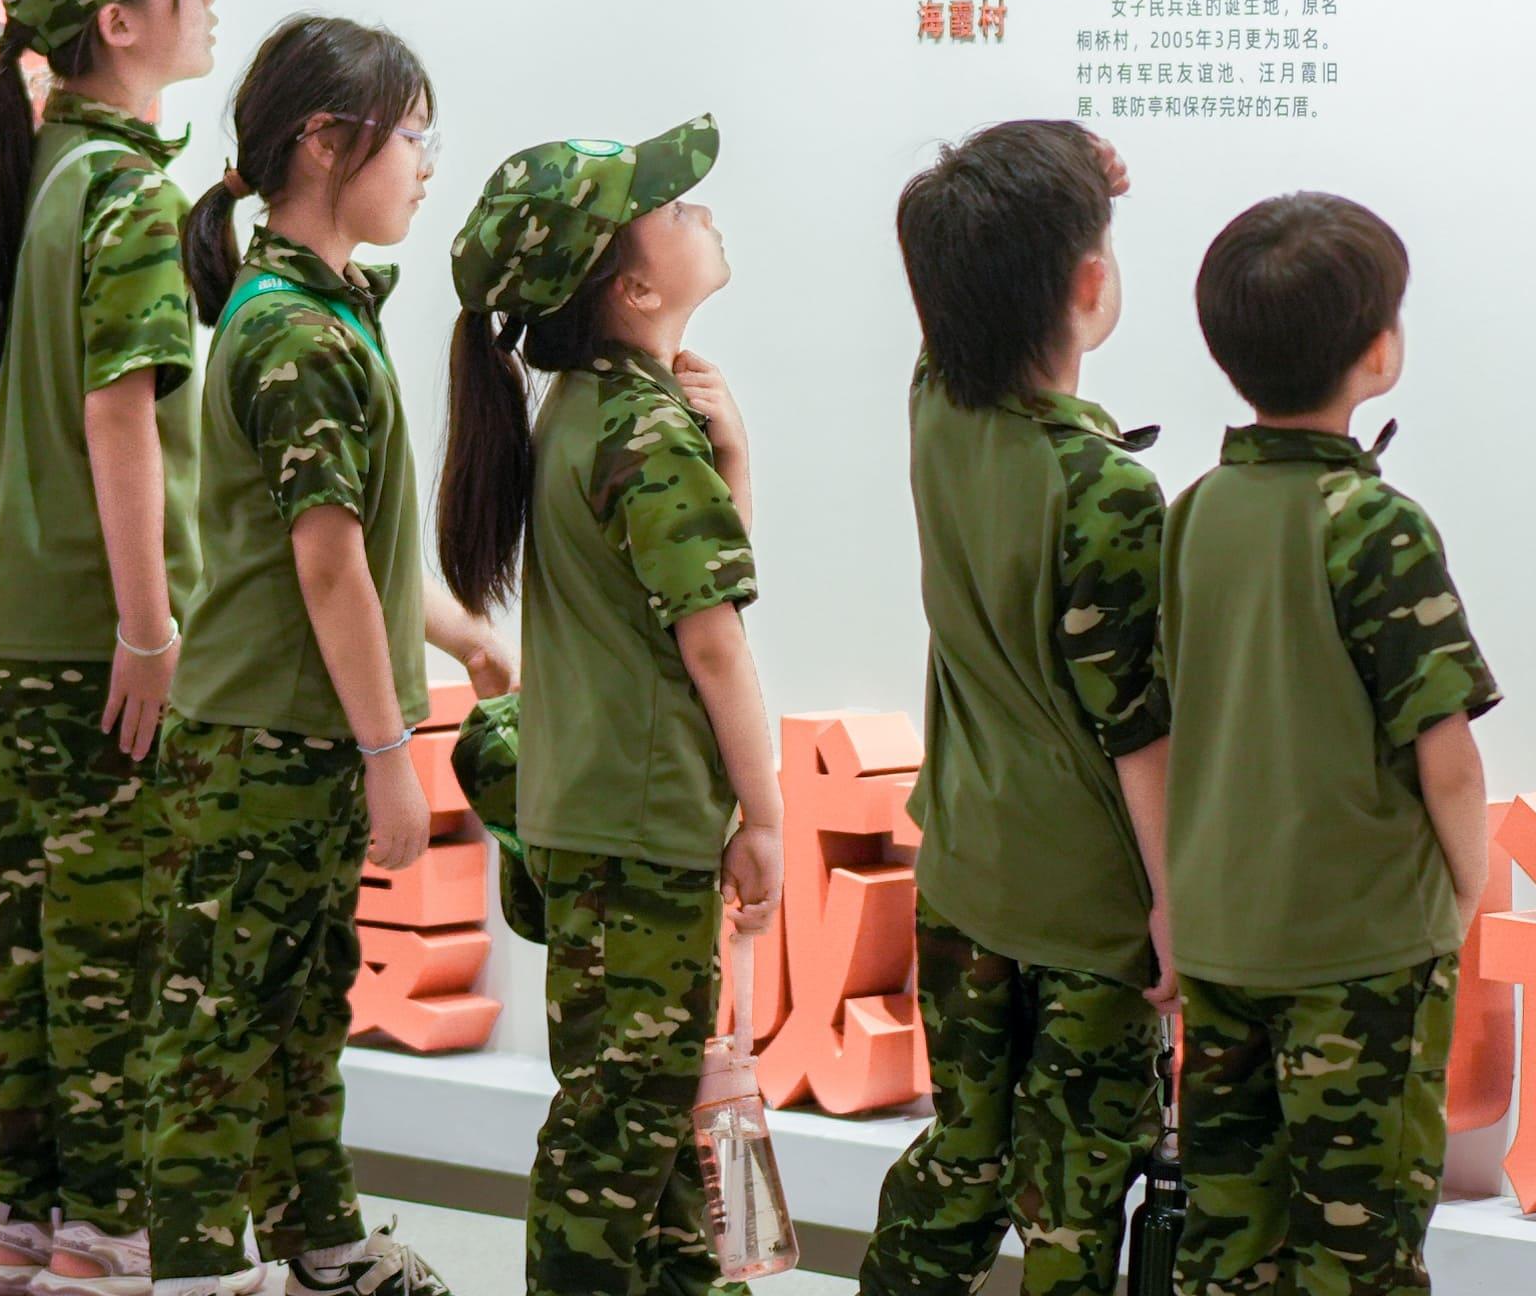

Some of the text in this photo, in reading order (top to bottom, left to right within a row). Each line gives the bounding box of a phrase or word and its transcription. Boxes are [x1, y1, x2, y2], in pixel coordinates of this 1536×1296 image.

[917, 0, 1008, 43] 海霞村
[1076, 61, 1339, 85] 村内有军民友谊池、汪月霞旧
